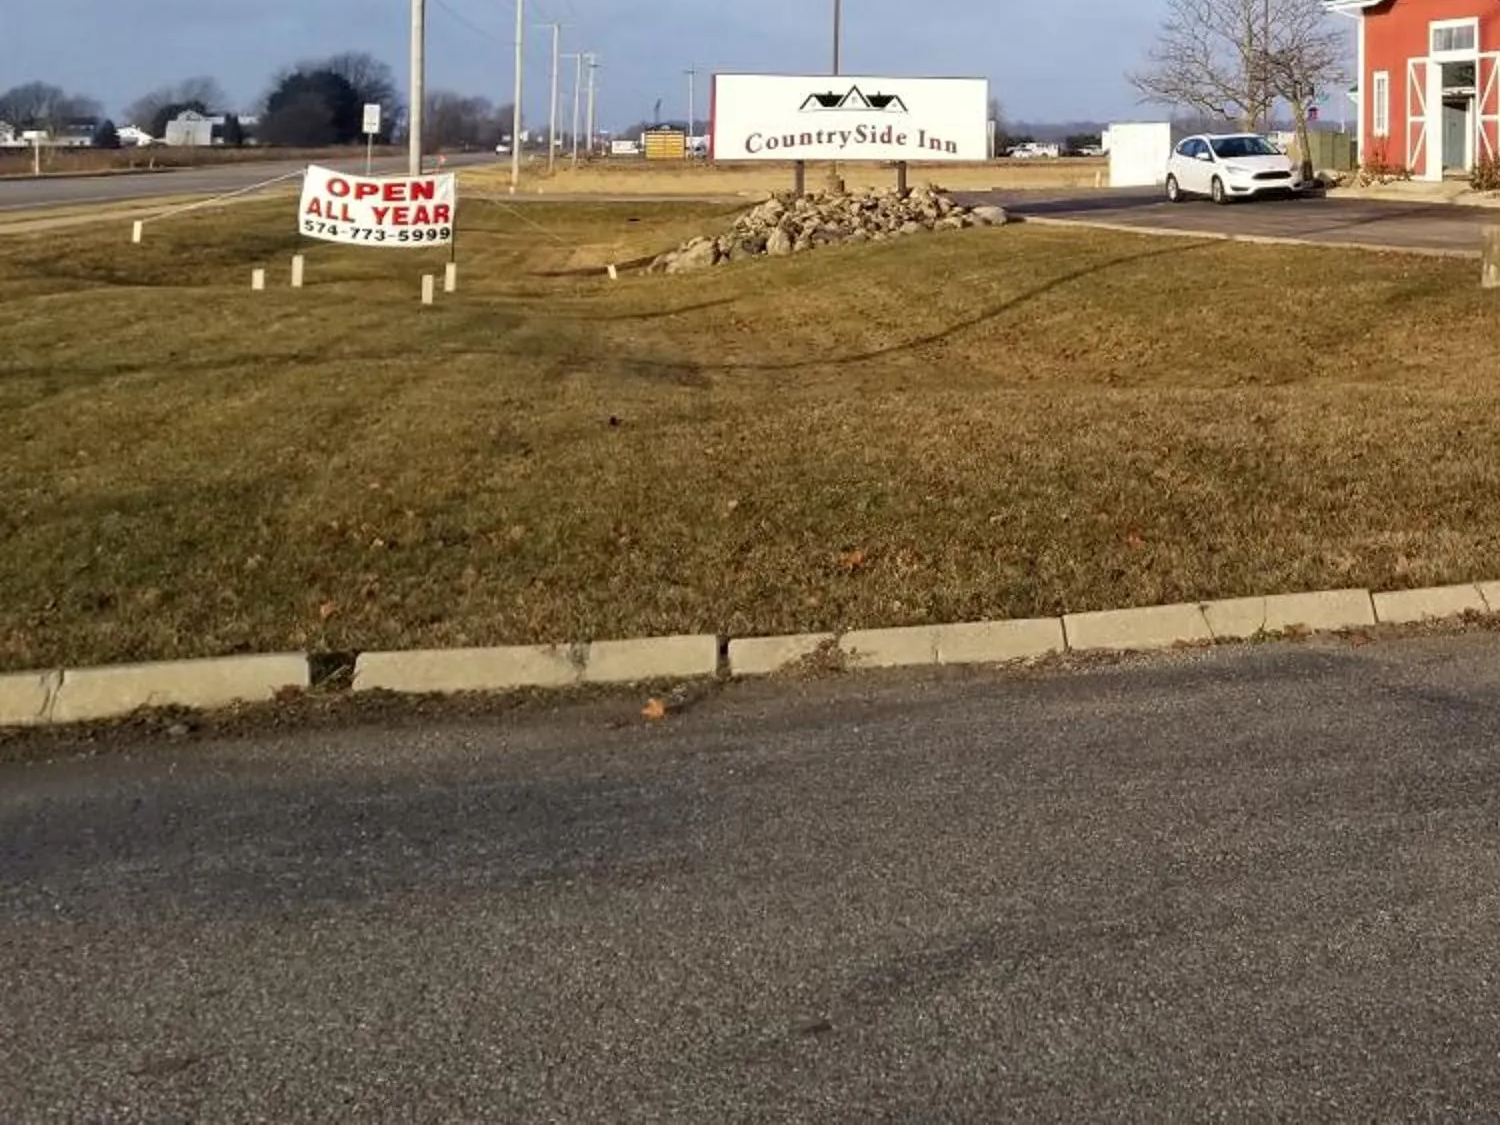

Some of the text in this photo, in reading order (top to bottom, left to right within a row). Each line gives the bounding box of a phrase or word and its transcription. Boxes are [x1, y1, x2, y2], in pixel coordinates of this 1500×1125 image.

[745, 124, 958, 154] CountrySide Inn
[326, 178, 434, 201] OPEN
[305, 197, 450, 225] ALL YEAR
[304, 220, 450, 241] 574-773-5999
